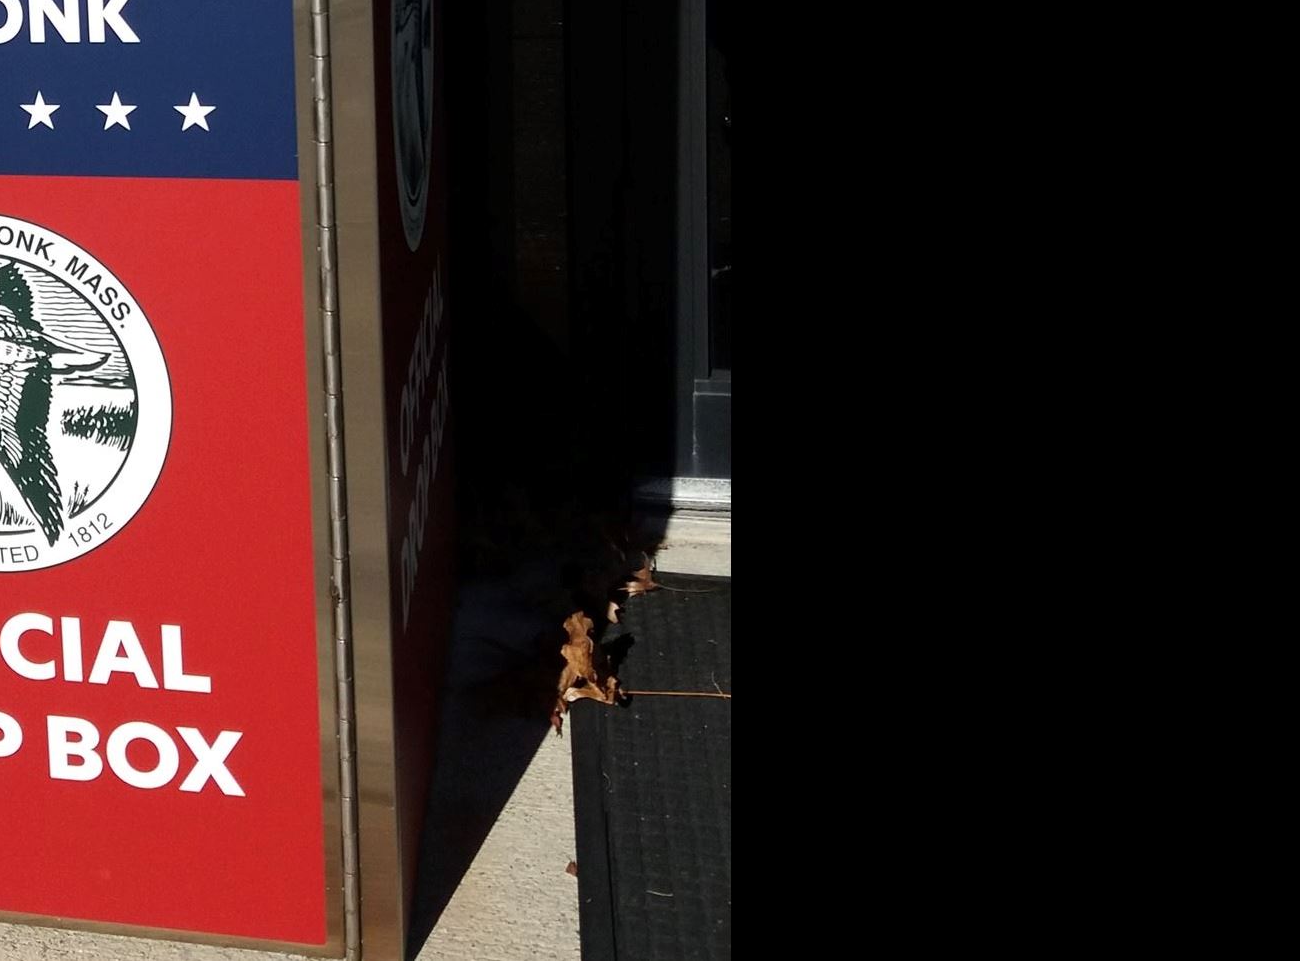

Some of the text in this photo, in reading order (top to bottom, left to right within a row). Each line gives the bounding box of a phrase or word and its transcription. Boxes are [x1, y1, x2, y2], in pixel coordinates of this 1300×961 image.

[64, 255, 132, 329] MASS.
[67, 512, 114, 548] 1812
[46, 715, 247, 798] BOX
